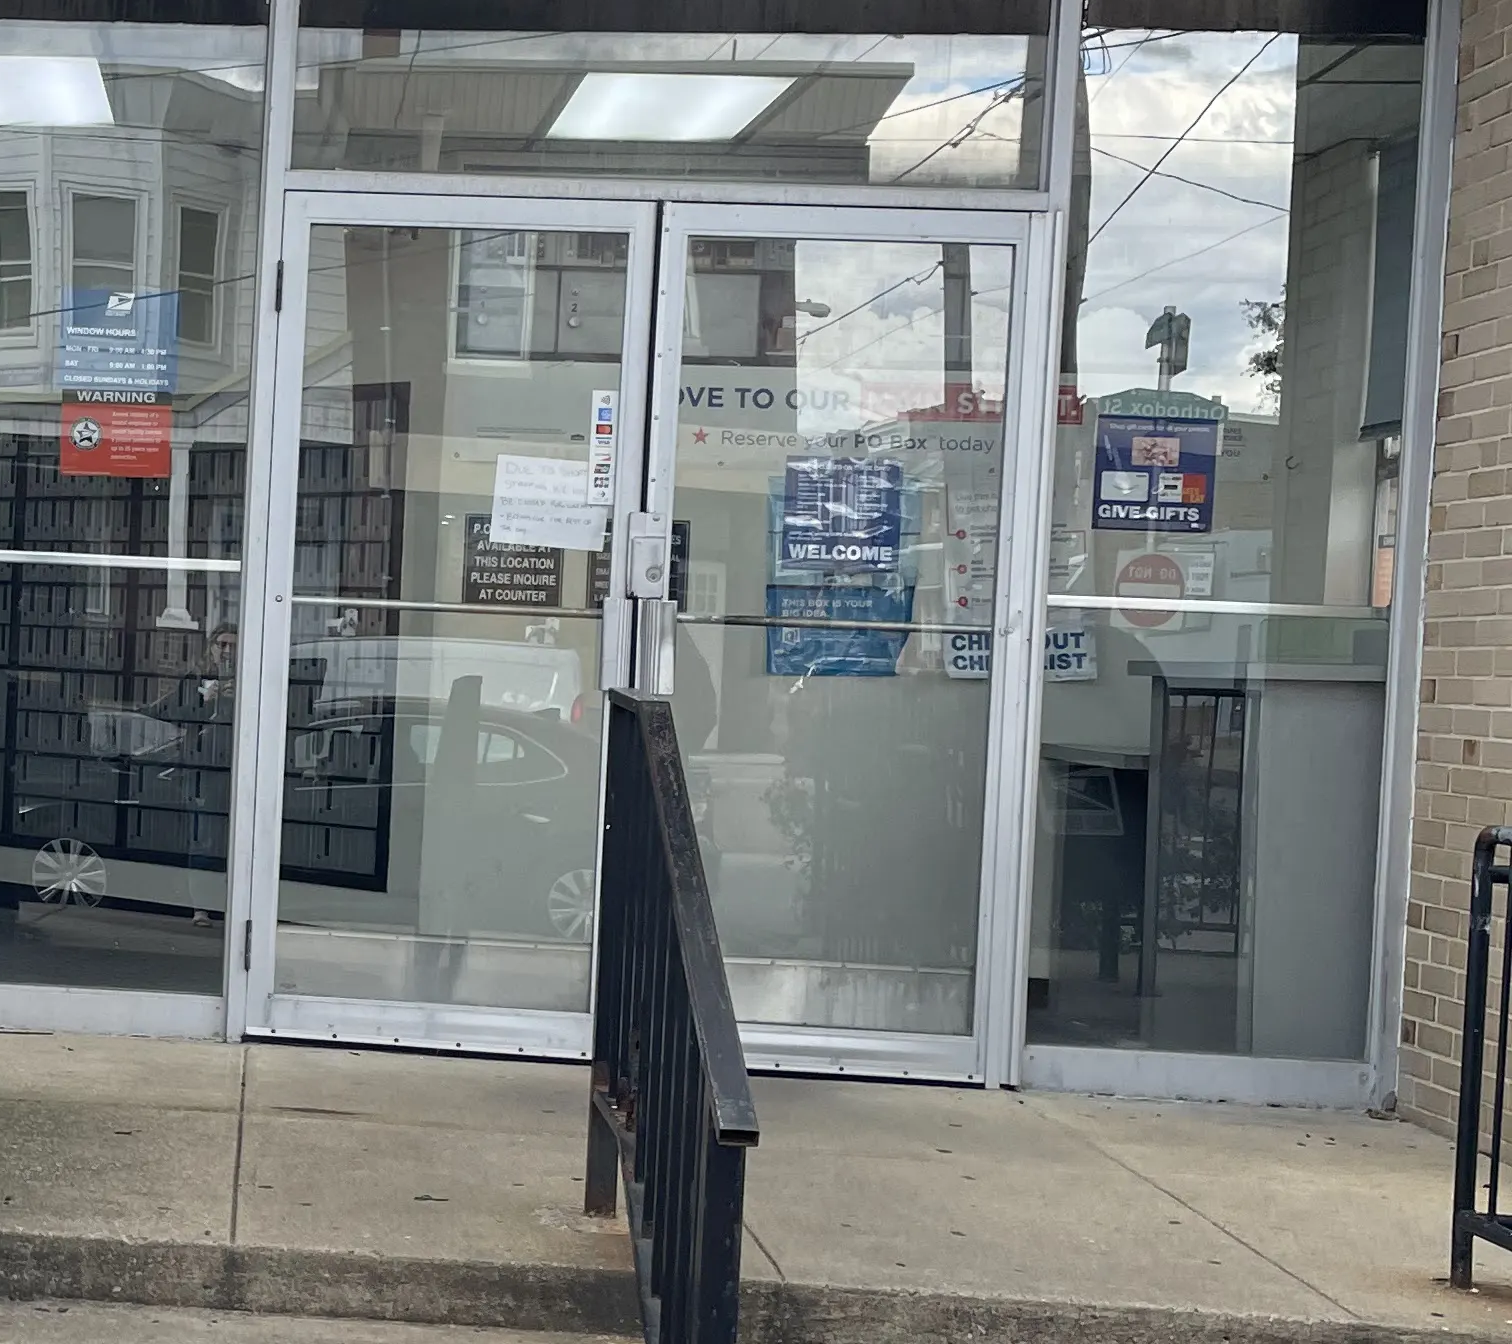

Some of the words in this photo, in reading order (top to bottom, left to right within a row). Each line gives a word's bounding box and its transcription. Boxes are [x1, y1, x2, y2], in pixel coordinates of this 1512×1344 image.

[67, 327, 104, 336] WINDOW
[106, 329, 136, 337] HOURS
[64, 375, 93, 383] CLOSED
[134, 378, 169, 386] HOLIDAYS
[76, 390, 156, 403] WARNING
[678, 386, 725, 408] VE
[734, 387, 775, 409] TO
[785, 388, 850, 412] OUR
[721, 429, 797, 448] Reserve
[804, 432, 850, 450] your
[854, 433, 882, 449] PO
[890, 434, 928, 450] Box
[939, 435, 995, 454] today
[1097, 504, 1141, 519] GIVE
[1144, 506, 1200, 522] GIFTS
[473, 523, 491, 535] P.O
[476, 539, 537, 553] AVAILABLE
[537, 544, 552, 553] AT
[788, 543, 893, 562] WELCOME
[474, 555, 499, 568] THIS
[500, 556, 555, 570] LOCATION
[470, 571, 512, 585] PLEASE
[512, 573, 557, 587] INQUIRE
[478, 588, 494, 601] AT
[495, 589, 547, 602] COUNTER
[781, 598, 805, 608] THIS
[807, 599, 830, 608] BOX
[832, 599, 842, 608] IS
[844, 599, 873, 608] YOUR
[781, 609, 800, 618] BIG
